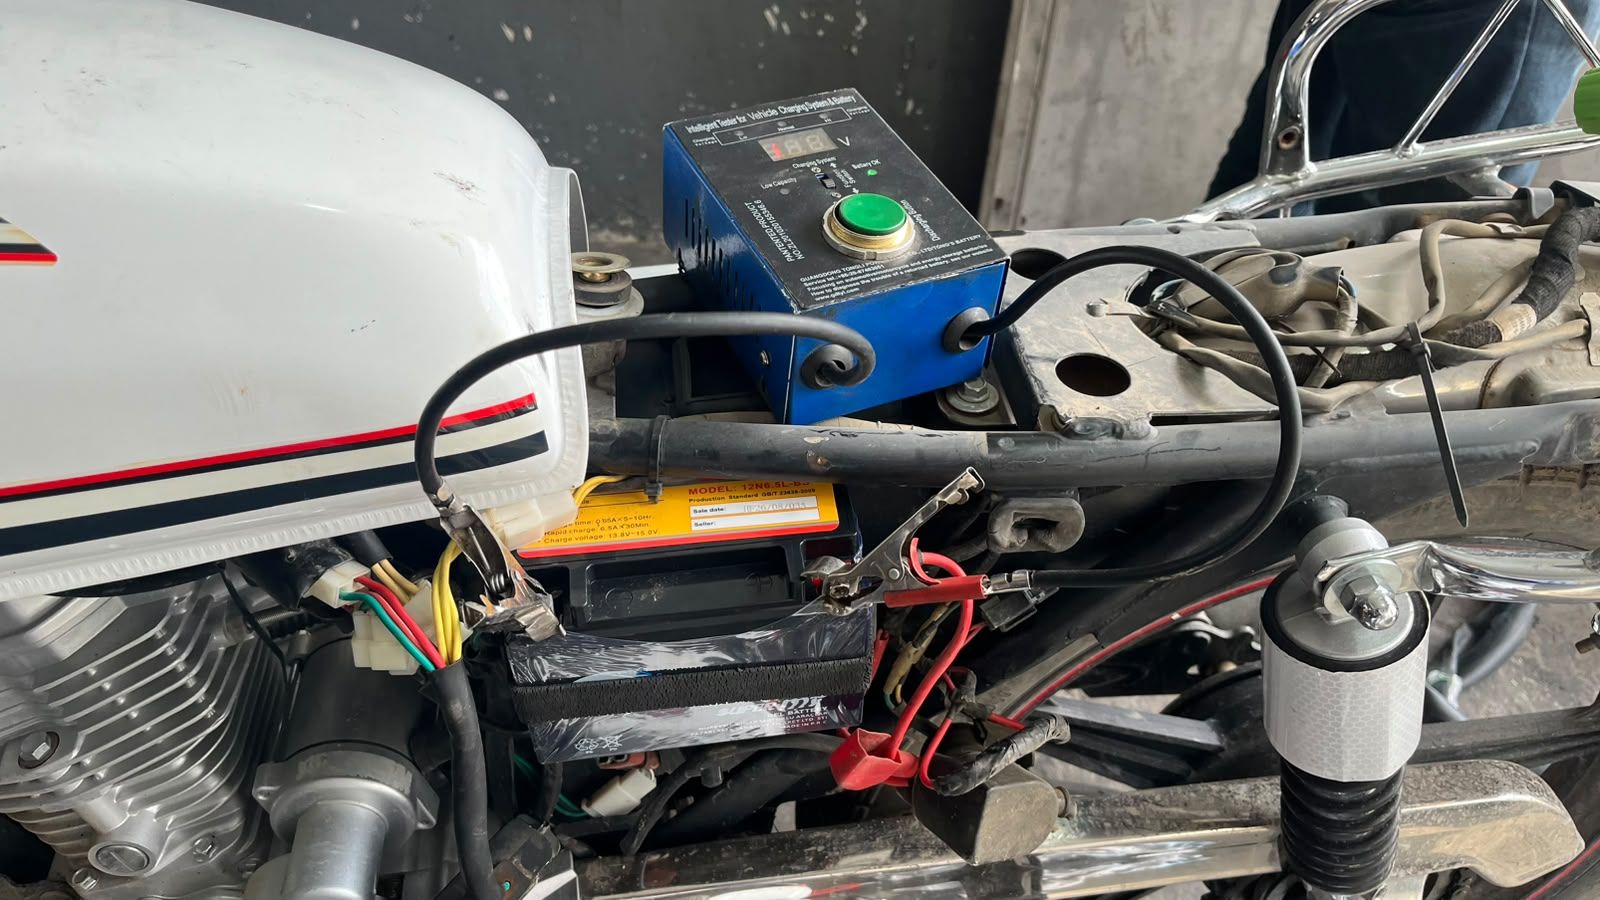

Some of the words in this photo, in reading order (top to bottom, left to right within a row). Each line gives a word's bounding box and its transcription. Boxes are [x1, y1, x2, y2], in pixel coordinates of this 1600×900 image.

[716, 118, 738, 127] Tester
[736, 115, 747, 123] for
[747, 108, 779, 120] Vehicle
[778, 104, 809, 114] Charging
[805, 101, 830, 110] System
[832, 96, 856, 104] Battery
[837, 136, 850, 147] V
[792, 160, 817, 169] Charging
[816, 156, 837, 165] System
[851, 161, 872, 170] Battery
[760, 182, 773, 190] Low
[772, 177, 797, 186] Capacity
[900, 199, 917, 215] Button
[744, 202, 770, 228] PRODUCT
[913, 213, 941, 242] Discharging
[765, 228, 795, 262] PANTENTED
[955, 234, 981, 245] BATTERY
[800, 269, 841, 282] GUANGDONG
[803, 279, 826, 287] Service
[807, 282, 835, 291] Focusing
[688, 486, 737, 495] MODEL:
[688, 495, 725, 503] Production
[728, 492, 759, 500] Standard
[787, 706, 828, 715] BATTEY
